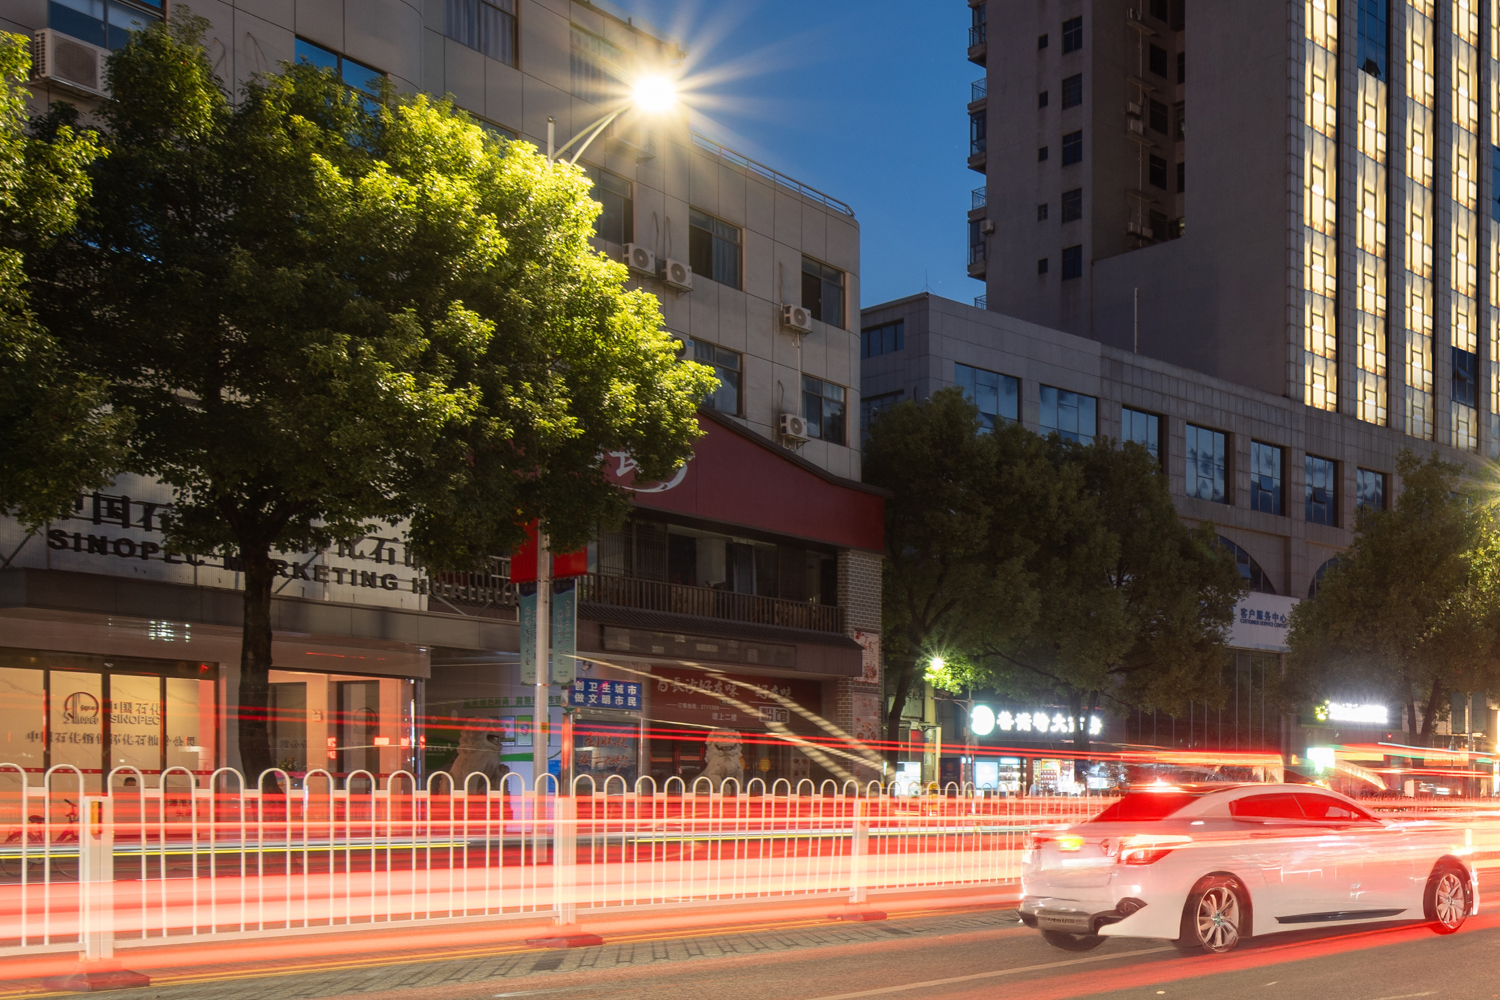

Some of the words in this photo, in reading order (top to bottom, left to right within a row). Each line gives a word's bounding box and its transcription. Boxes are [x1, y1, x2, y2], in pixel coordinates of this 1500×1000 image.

[223, 554, 399, 591] MRKETING
[1240, 607, 1287, 623] 客户服务中心
[574, 680, 637, 695] 创卫生城市
[574, 692, 637, 707] 做文明市民
[110, 714, 160, 725] SINOPEC
